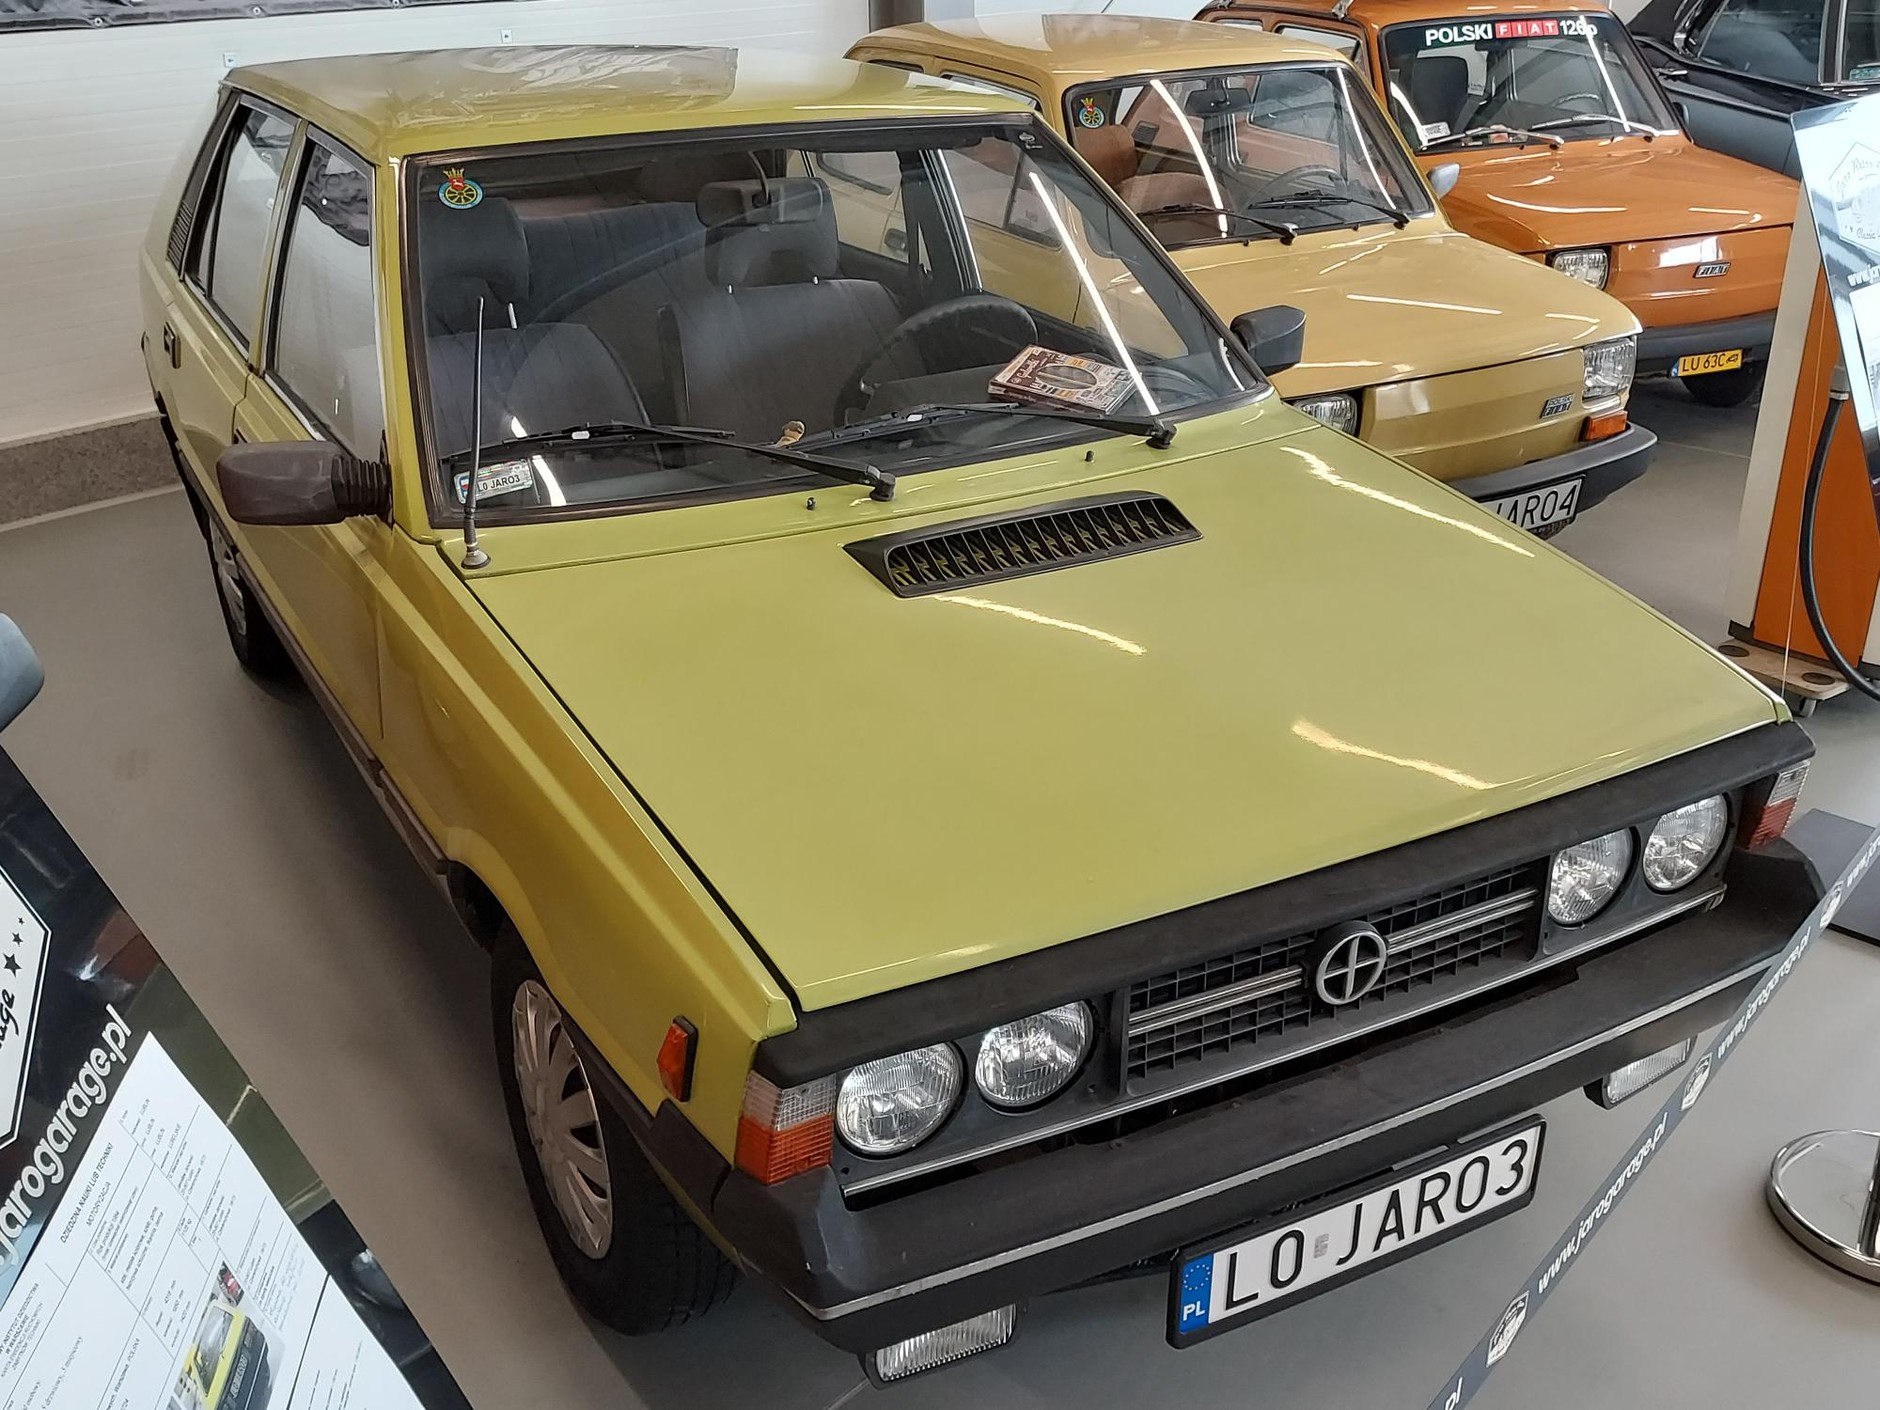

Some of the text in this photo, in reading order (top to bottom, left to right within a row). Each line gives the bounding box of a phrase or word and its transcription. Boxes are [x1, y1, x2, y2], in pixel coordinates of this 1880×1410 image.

[1425, 23, 1493, 46] POLSKI
[1499, 21, 1556, 37] FIAT
[1682, 353, 1726, 372] LU 63C
[490, 474, 521, 489] JARO3
[59, 1141, 113, 1244] DZIEDZINA NAUKI LUB TECHNIKI
[1336, 1138, 1528, 1266] JARO3
[1538, 1111, 1669, 1294] www.jarogarage.pl
[1183, 1300, 1206, 1321] PL
